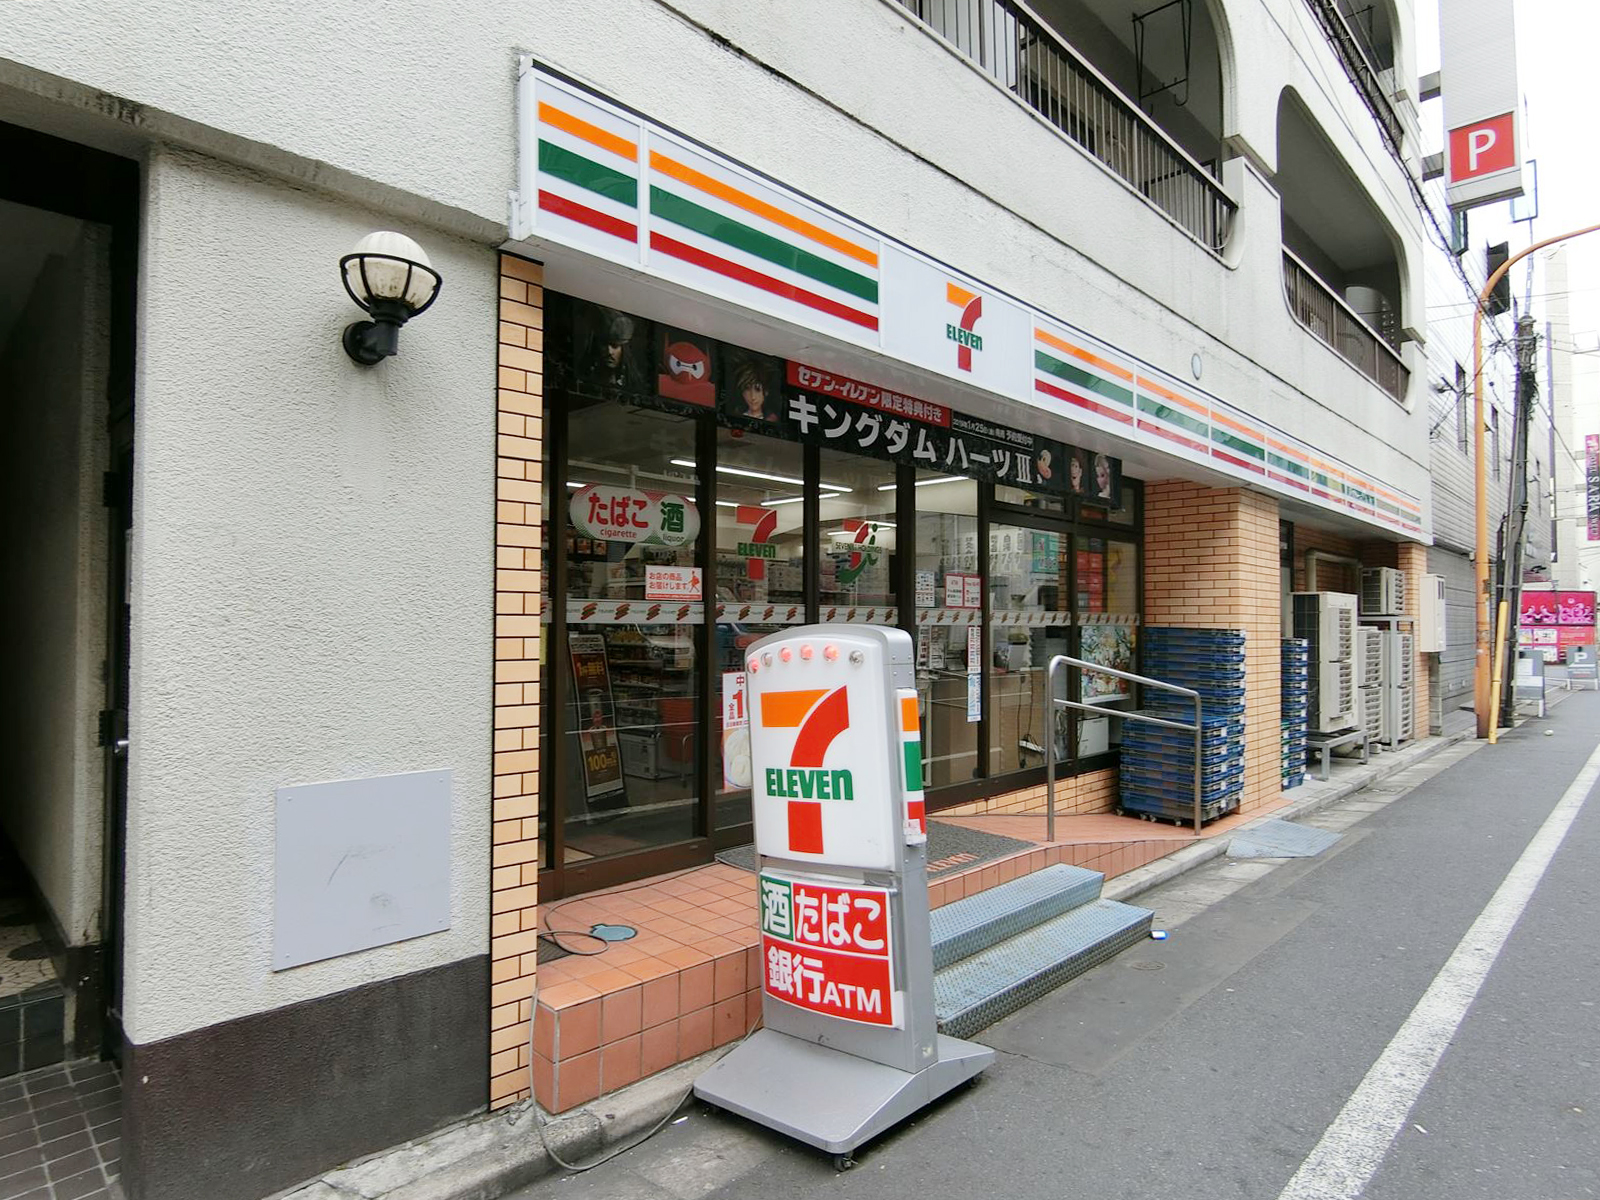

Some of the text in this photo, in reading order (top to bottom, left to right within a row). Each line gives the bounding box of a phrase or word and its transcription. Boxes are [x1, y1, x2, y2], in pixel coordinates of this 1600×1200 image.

[1468, 129, 1496, 172] P
[588, 492, 649, 529] たばこ
[1588, 476, 1600, 512] SARA
[600, 528, 637, 539] cigarette
[660, 501, 685, 533] 酒
[662, 533, 685, 543] liquor
[762, 880, 884, 950] 酒 たばこ
